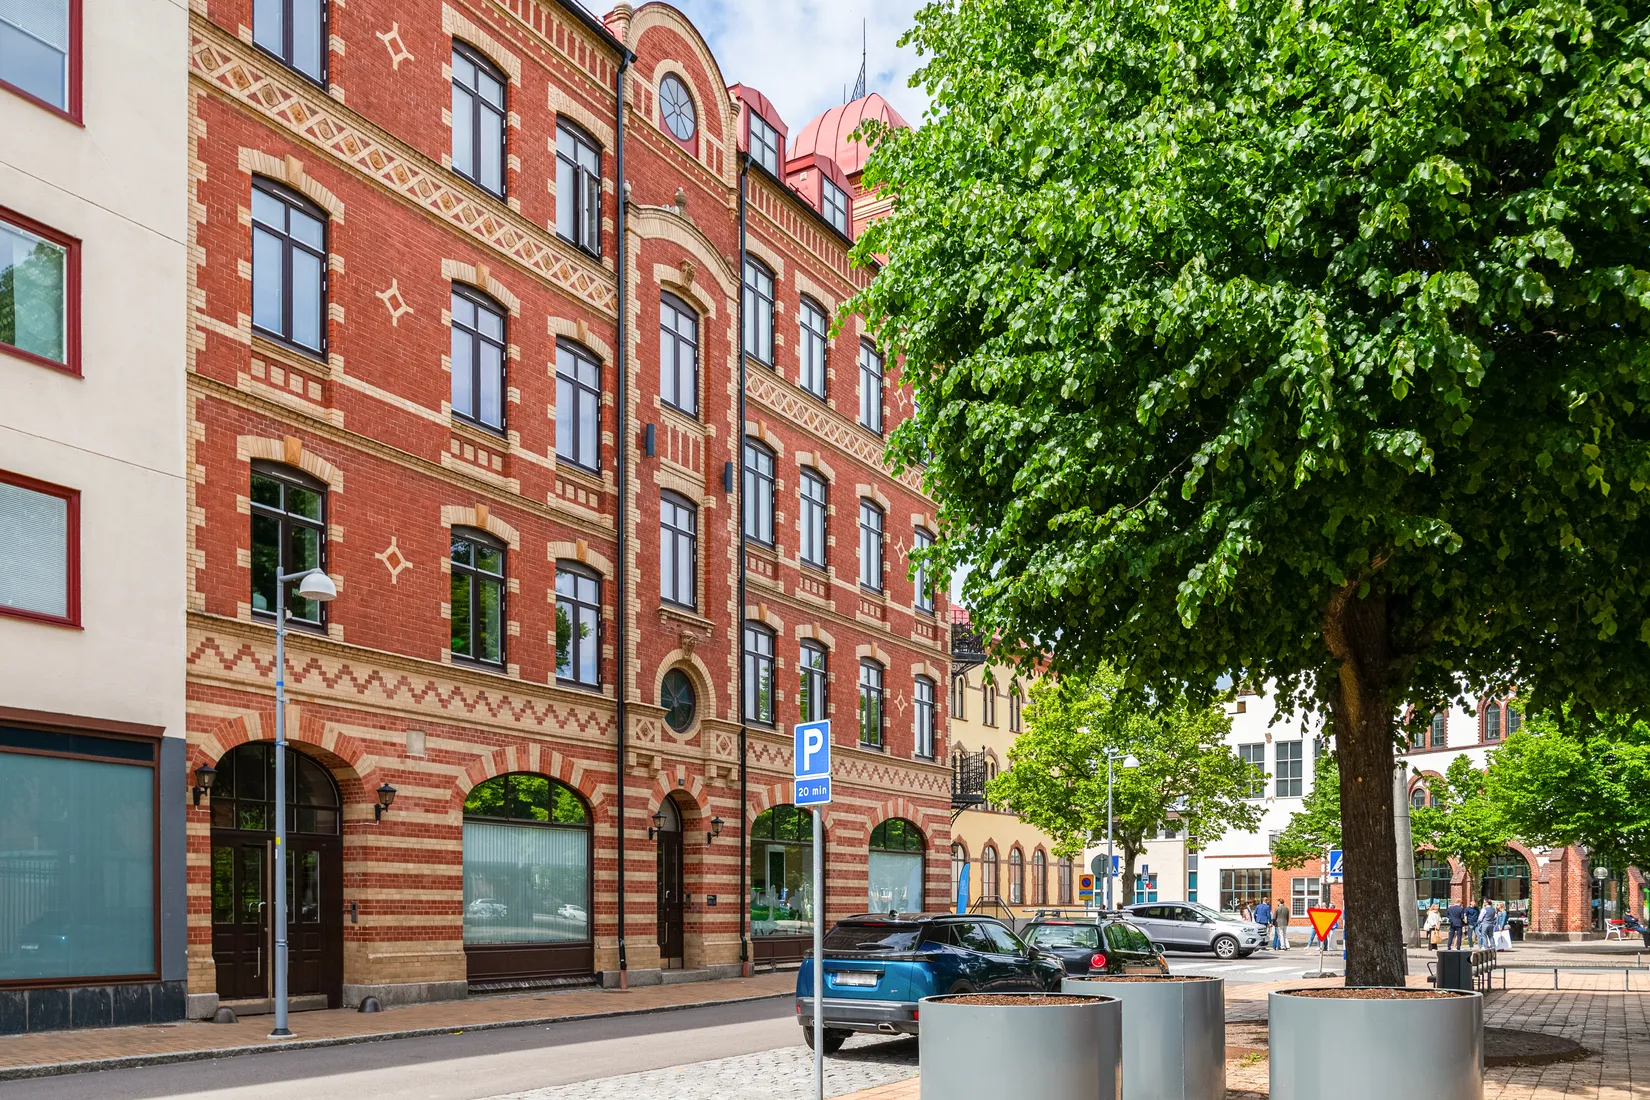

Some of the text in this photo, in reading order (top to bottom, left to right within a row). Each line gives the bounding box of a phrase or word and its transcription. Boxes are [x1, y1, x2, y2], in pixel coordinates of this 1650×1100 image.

[803, 728, 823, 772] P
[798, 785, 827, 797] 20 min
